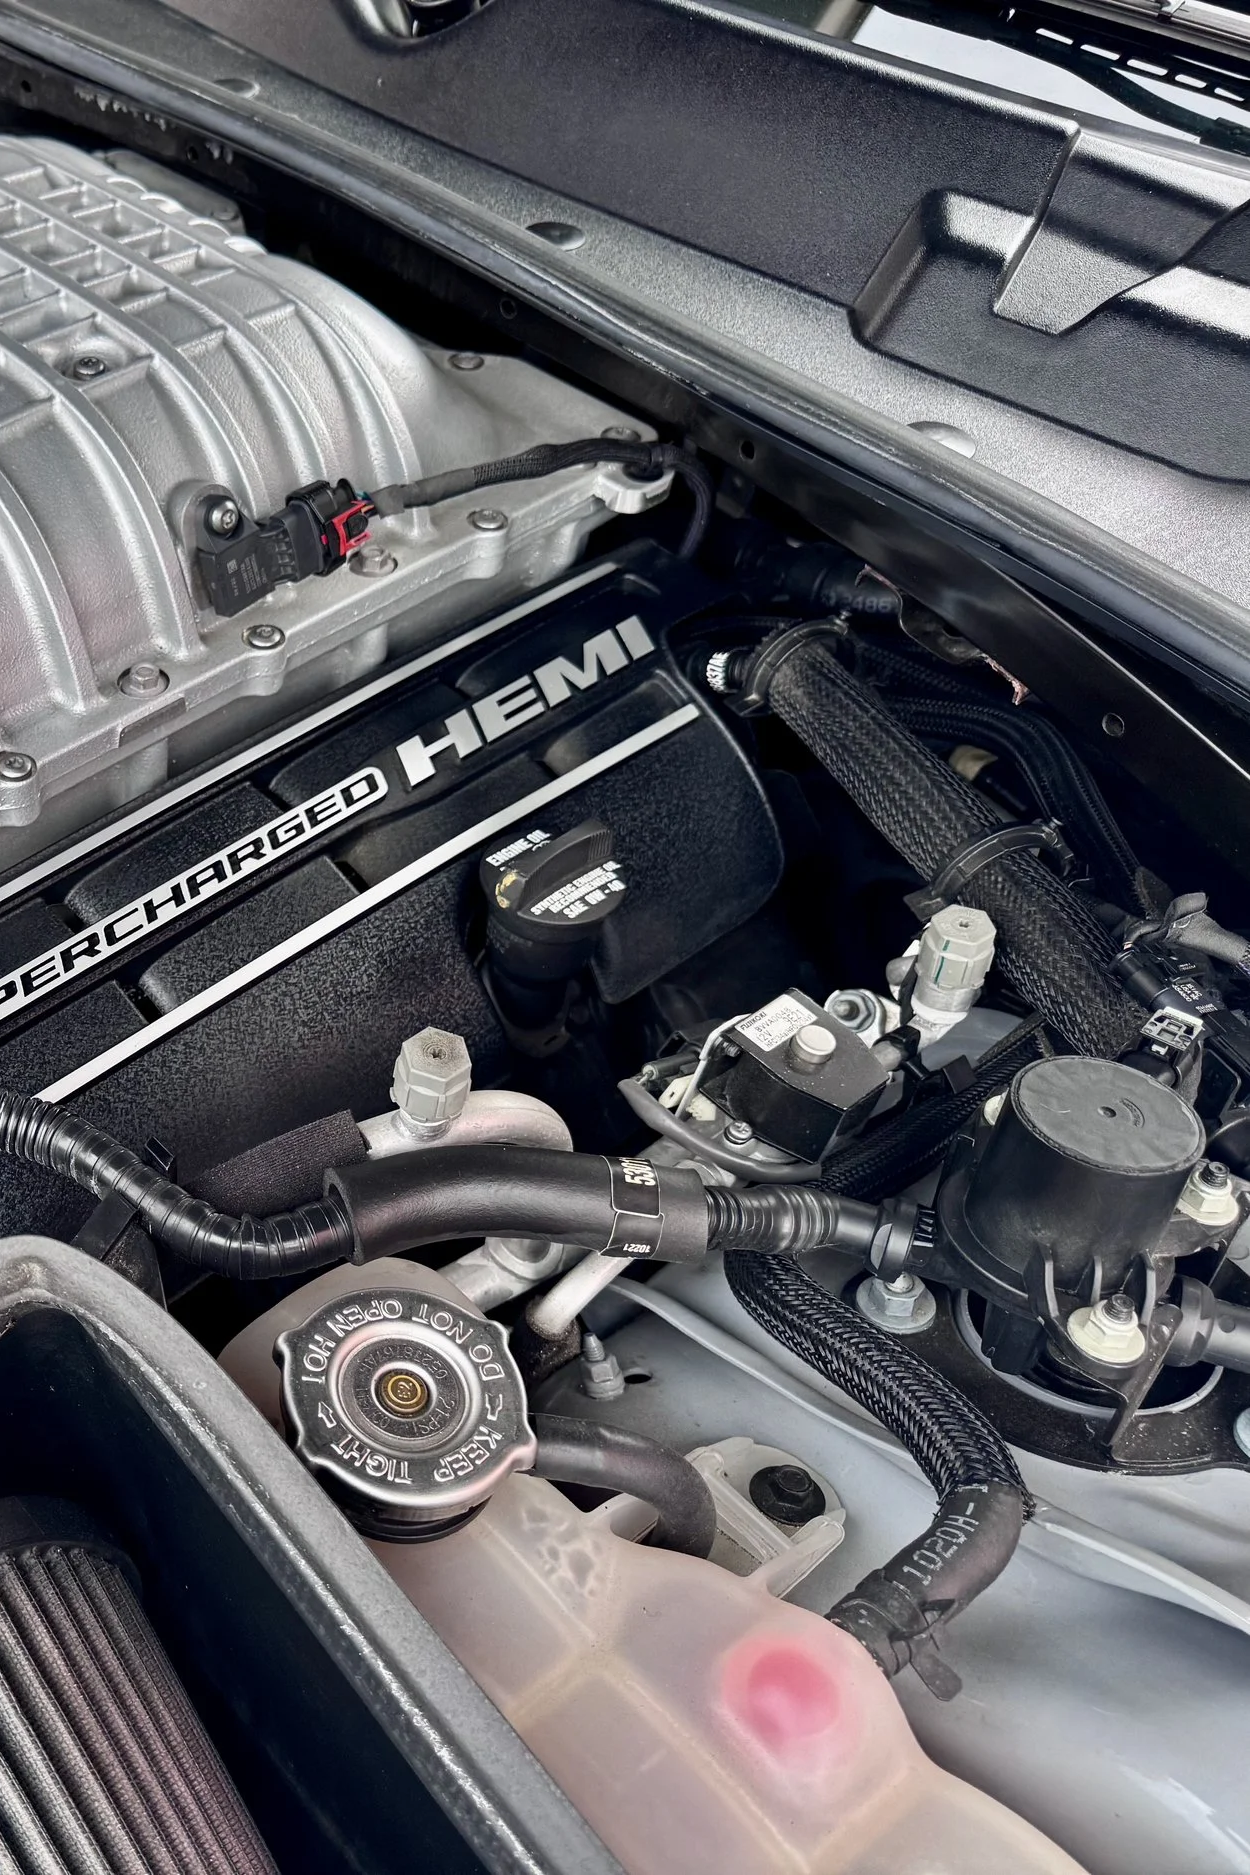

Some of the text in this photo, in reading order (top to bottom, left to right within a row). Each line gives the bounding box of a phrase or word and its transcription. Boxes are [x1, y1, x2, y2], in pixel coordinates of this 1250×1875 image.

[397, 615, 656, 788] HEMI
[486, 829, 552, 867] ENGINE OIL
[530, 883, 577, 916] SYNTHETIC
[548, 871, 619, 914] RECOMMENDED
[562, 900, 590, 919] SAE
[740, 1011, 767, 1031] FUJIKOKI
[301, 1299, 505, 1384] DO NOT OPEN HOT
[330, 1425, 503, 1485] KEEP TIGHT
